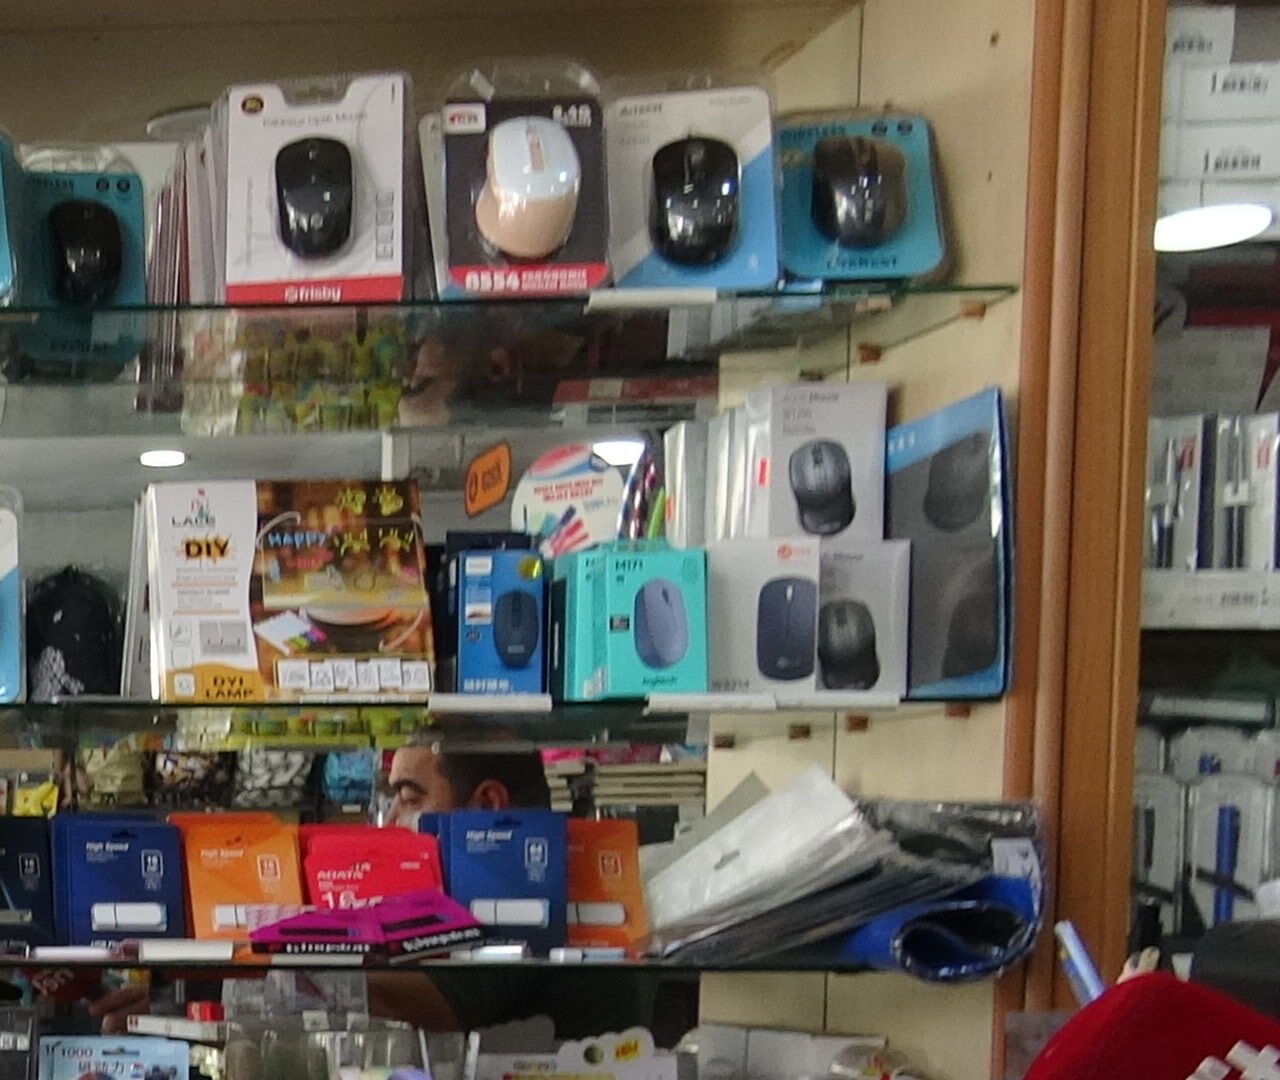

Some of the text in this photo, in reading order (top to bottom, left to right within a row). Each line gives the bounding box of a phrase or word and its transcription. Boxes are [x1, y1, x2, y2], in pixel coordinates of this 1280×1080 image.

[297, 286, 341, 303] frisby
[184, 538, 230, 560] DIY
[267, 532, 326, 549] HAPPY
